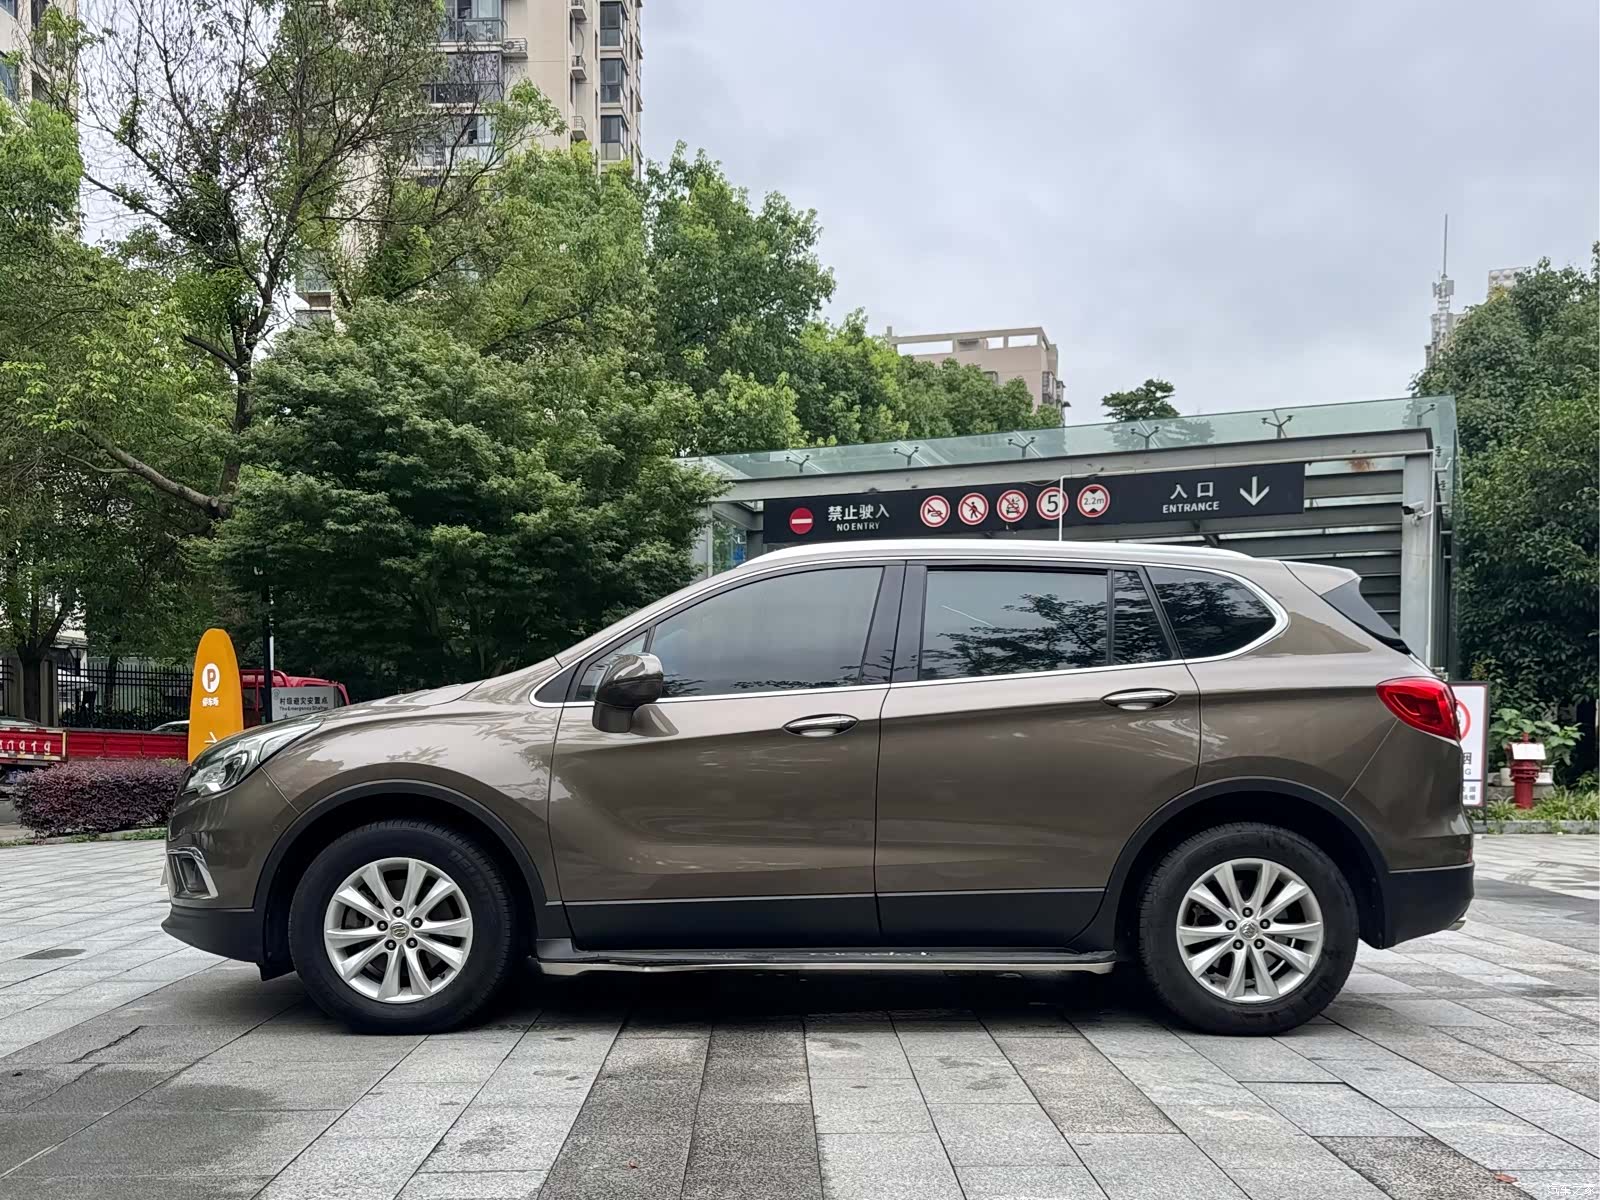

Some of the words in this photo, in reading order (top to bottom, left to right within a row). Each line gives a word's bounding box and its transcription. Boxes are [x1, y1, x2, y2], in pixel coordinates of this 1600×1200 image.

[1170, 482, 1214, 499] 入口
[1047, 494, 1058, 512] 5
[1083, 497, 1105, 505] 2.2m
[1162, 501, 1220, 513] ENTRANCE
[828, 504, 890, 521] 禁止驶入
[836, 523, 850, 532] NO
[851, 521, 880, 531] ENTRY
[207, 669, 216, 689] P
